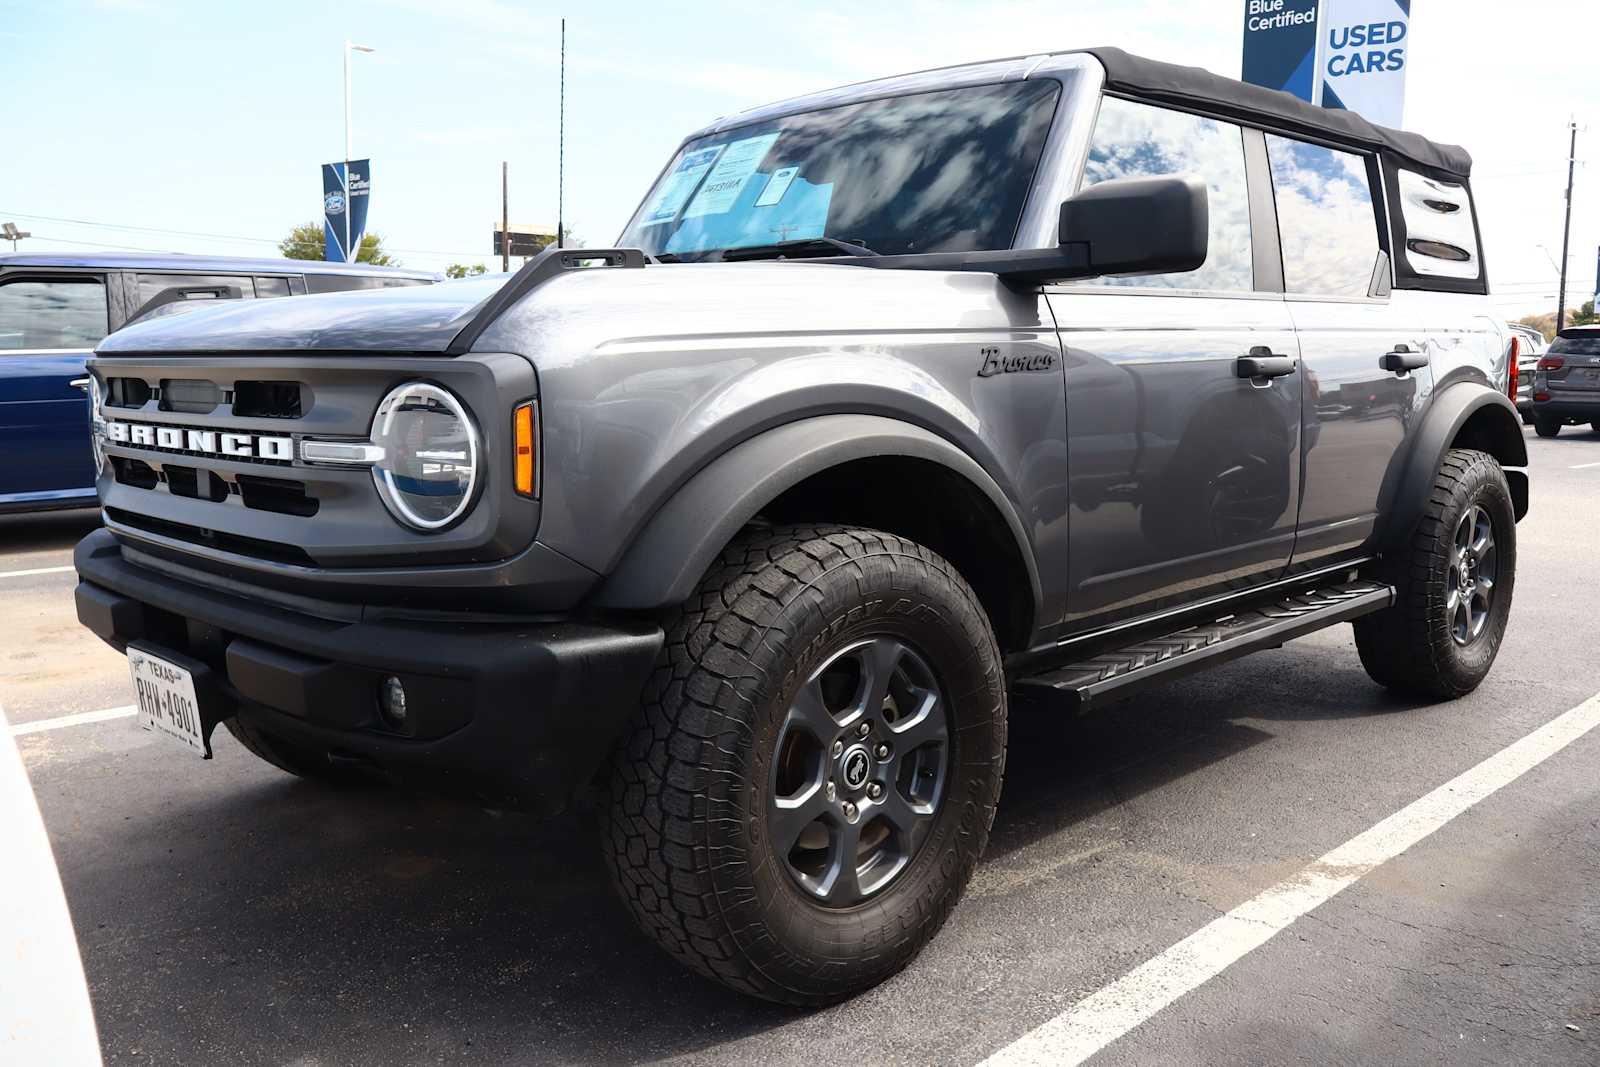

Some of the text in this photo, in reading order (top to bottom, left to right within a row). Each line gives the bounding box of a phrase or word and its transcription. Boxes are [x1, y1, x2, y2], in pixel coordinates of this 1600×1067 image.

[1248, 7, 1315, 32] Certified
[1249, 0, 1284, 15] Blue
[1329, 21, 1407, 50] USED
[1327, 48, 1404, 77] CARS
[977, 346, 1056, 378] Bronco
[109, 421, 294, 461] BRONCO
[148, 660, 175, 684] TEXAS
